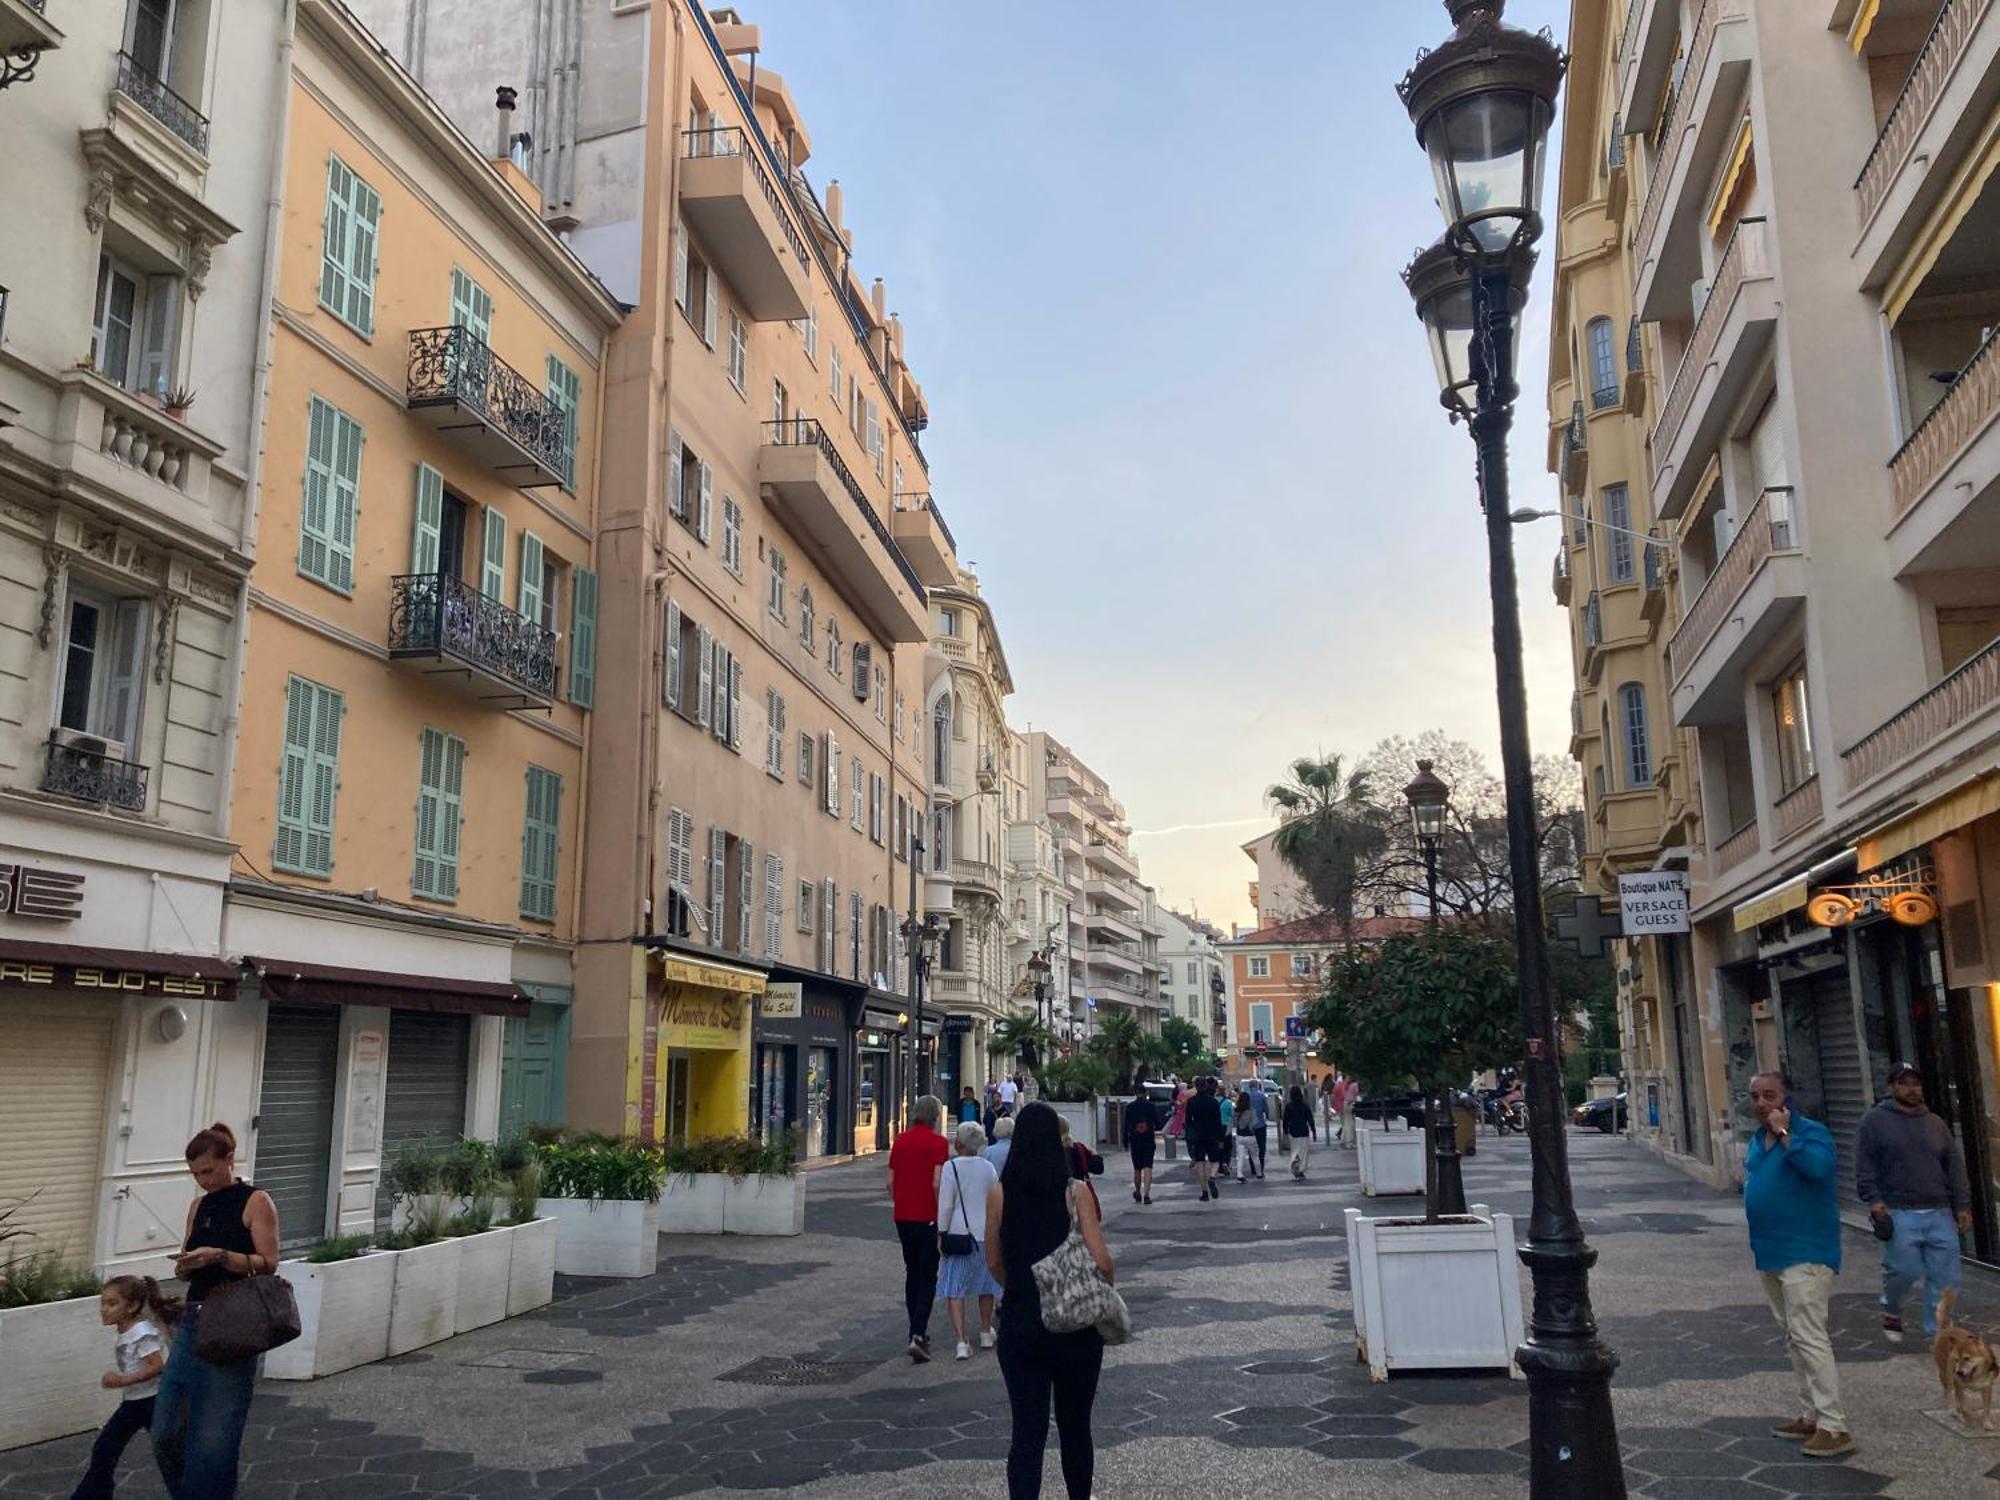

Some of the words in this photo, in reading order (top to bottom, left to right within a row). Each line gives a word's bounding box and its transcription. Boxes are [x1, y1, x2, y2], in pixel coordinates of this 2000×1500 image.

[1621, 882, 1657, 895] Boutique
[1625, 900, 1685, 912] VERSACE
[1635, 914, 1678, 925] GUESS
[74, 968, 224, 997] SUD-EST
